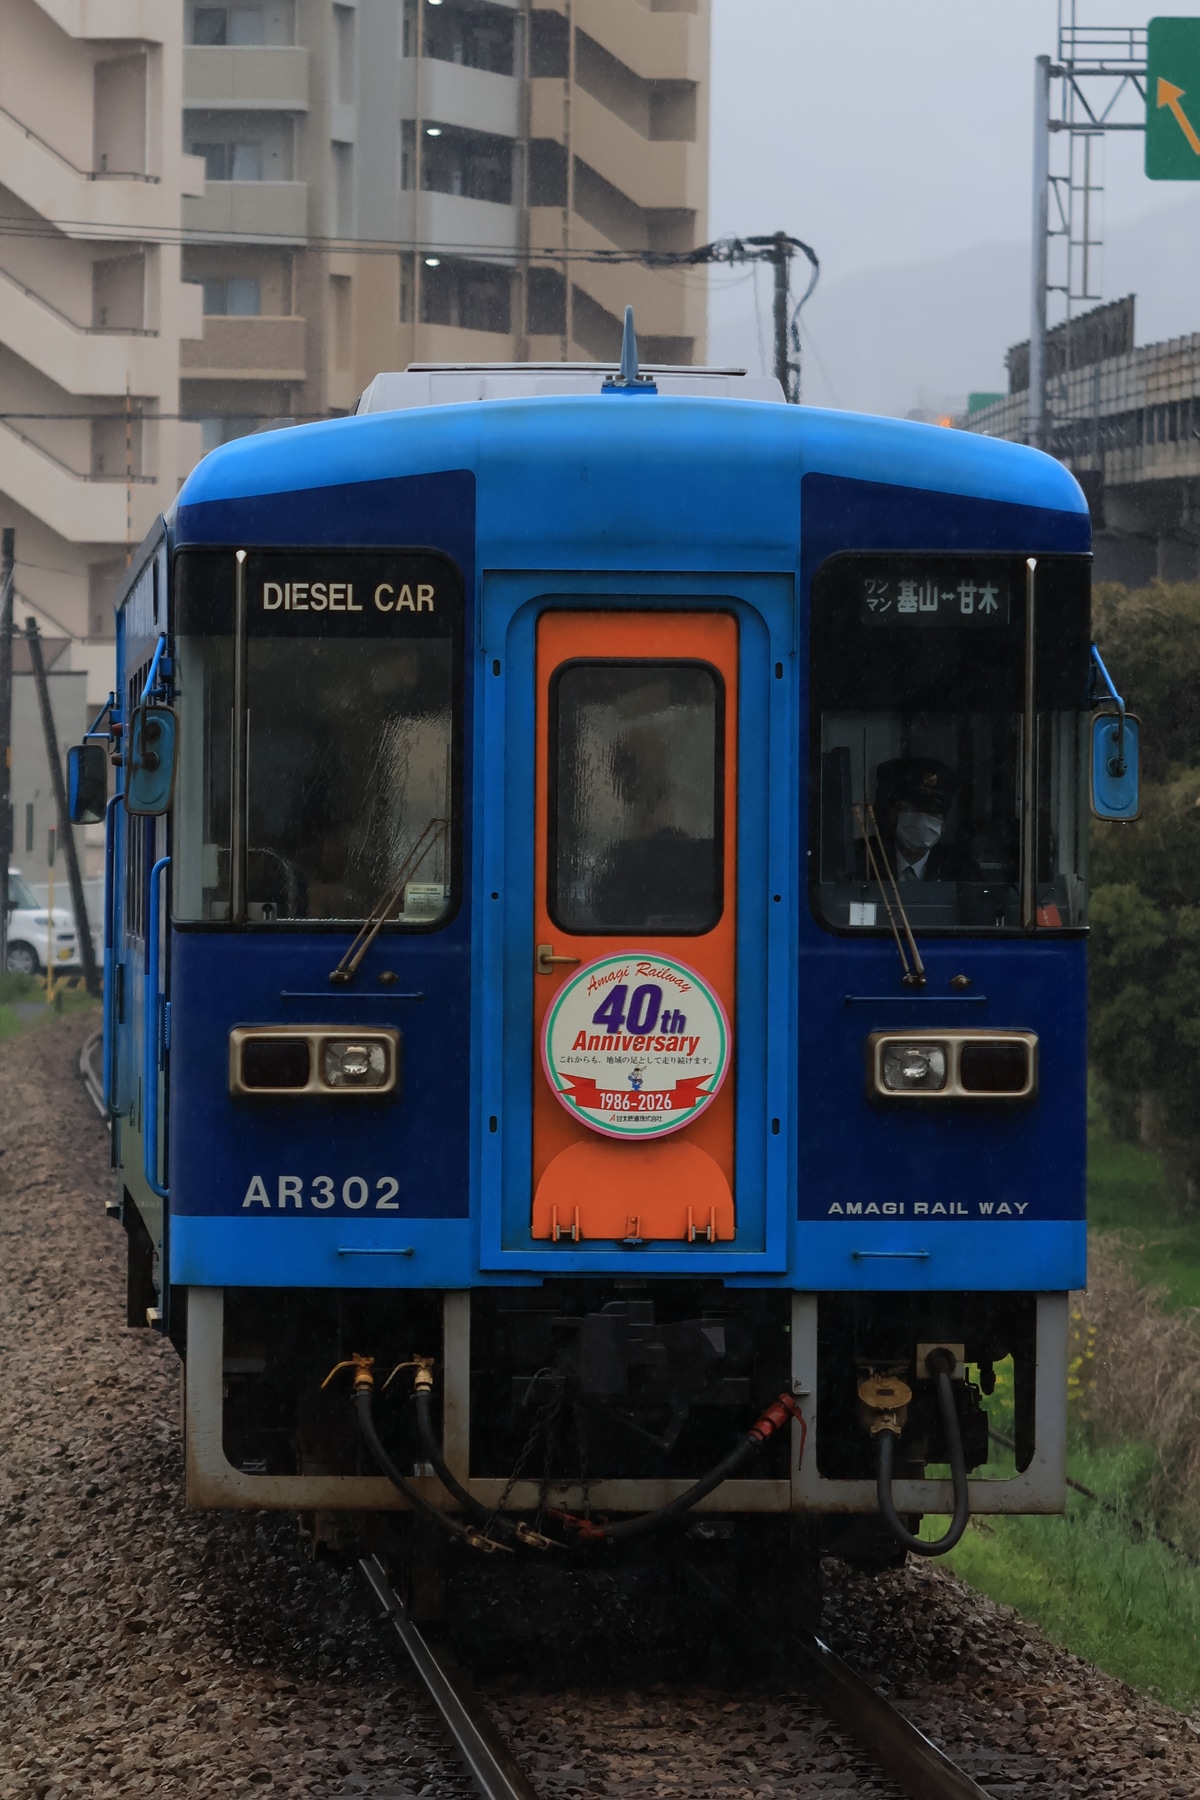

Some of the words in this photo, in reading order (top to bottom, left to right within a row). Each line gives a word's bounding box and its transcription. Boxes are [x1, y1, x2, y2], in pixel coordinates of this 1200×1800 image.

[263, 582, 363, 611] DIESEL
[374, 583, 435, 612] CAR
[865, 579, 889, 594] ワン
[897, 579, 938, 613] 基山
[956, 579, 999, 614] 甘木
[866, 597, 892, 612] マン
[587, 966, 630, 996] Amagi
[635, 962, 692, 993] Railway
[592, 984, 687, 1035] 40th
[571, 1030, 701, 1056] Anniversary
[600, 1092, 673, 1111] 1986-2026
[241, 1175, 400, 1210] AR302
[828, 1202, 905, 1215] AMAGI
[914, 1202, 969, 1215] RAIL
[978, 1202, 1029, 1215] WAY
